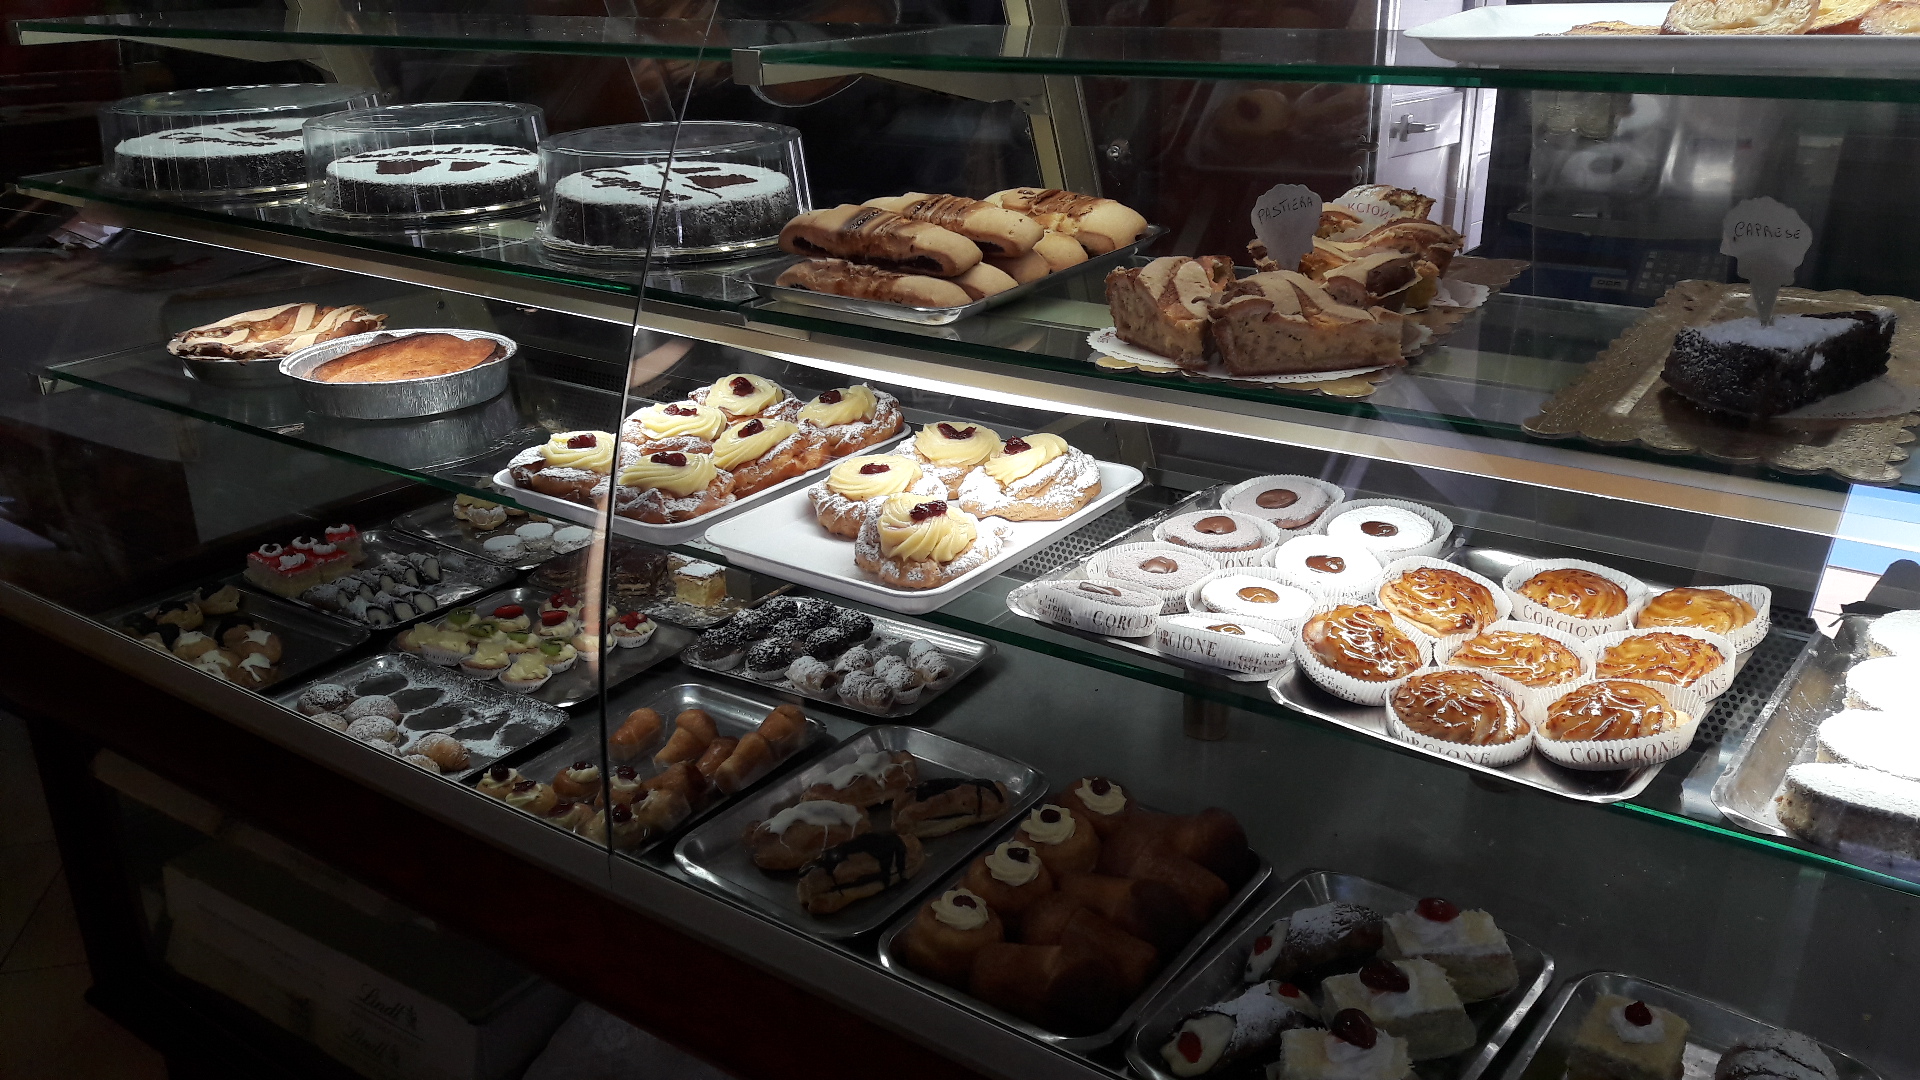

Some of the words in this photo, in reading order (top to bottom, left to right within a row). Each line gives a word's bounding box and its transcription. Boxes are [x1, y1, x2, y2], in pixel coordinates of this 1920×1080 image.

[1258, 197, 1313, 224] PASTIERA
[1734, 221, 1801, 241] CAPRESE
[1570, 735, 1680, 764] CORCIONE
